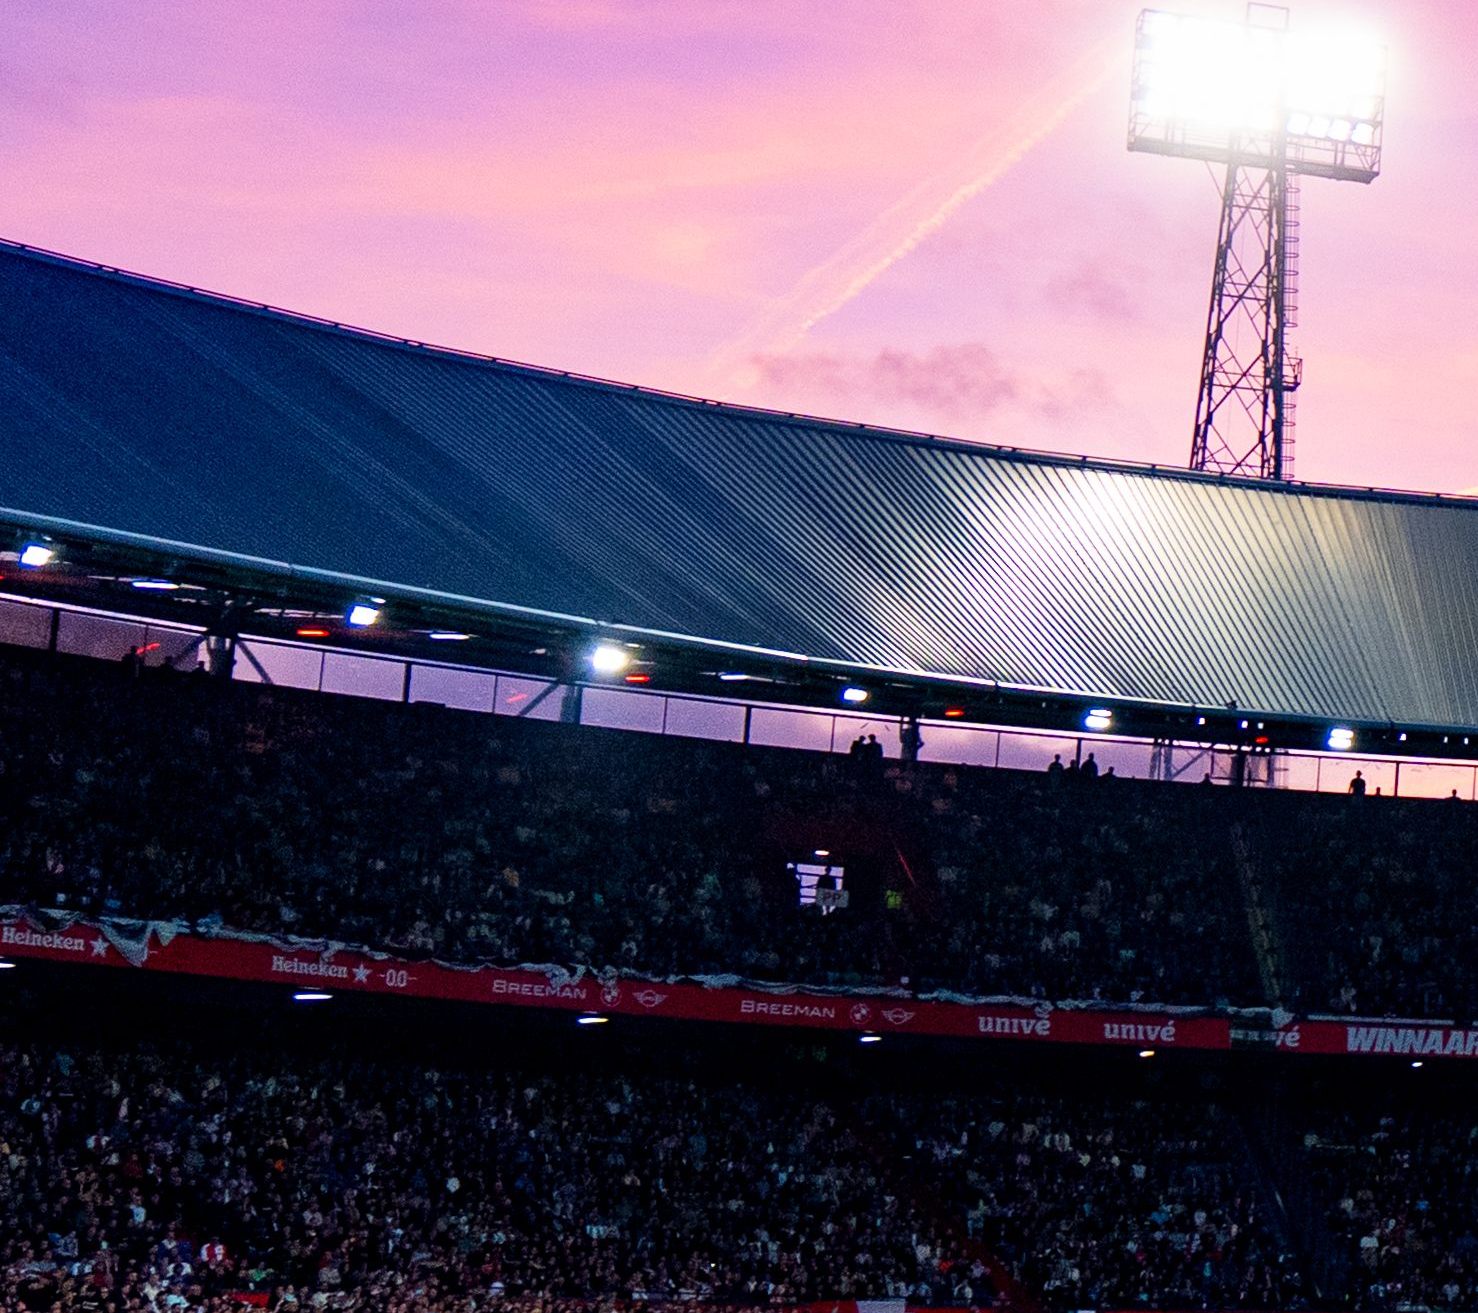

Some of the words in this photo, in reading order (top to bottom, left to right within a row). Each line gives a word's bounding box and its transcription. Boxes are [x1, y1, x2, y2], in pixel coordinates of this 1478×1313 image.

[1, 927, 85, 953] Heineken
[271, 955, 348, 979] Heineken
[492, 979, 587, 1000] BREEMAN
[740, 1000, 835, 1019] BREEMAN
[1104, 1020, 1176, 1042] univé
